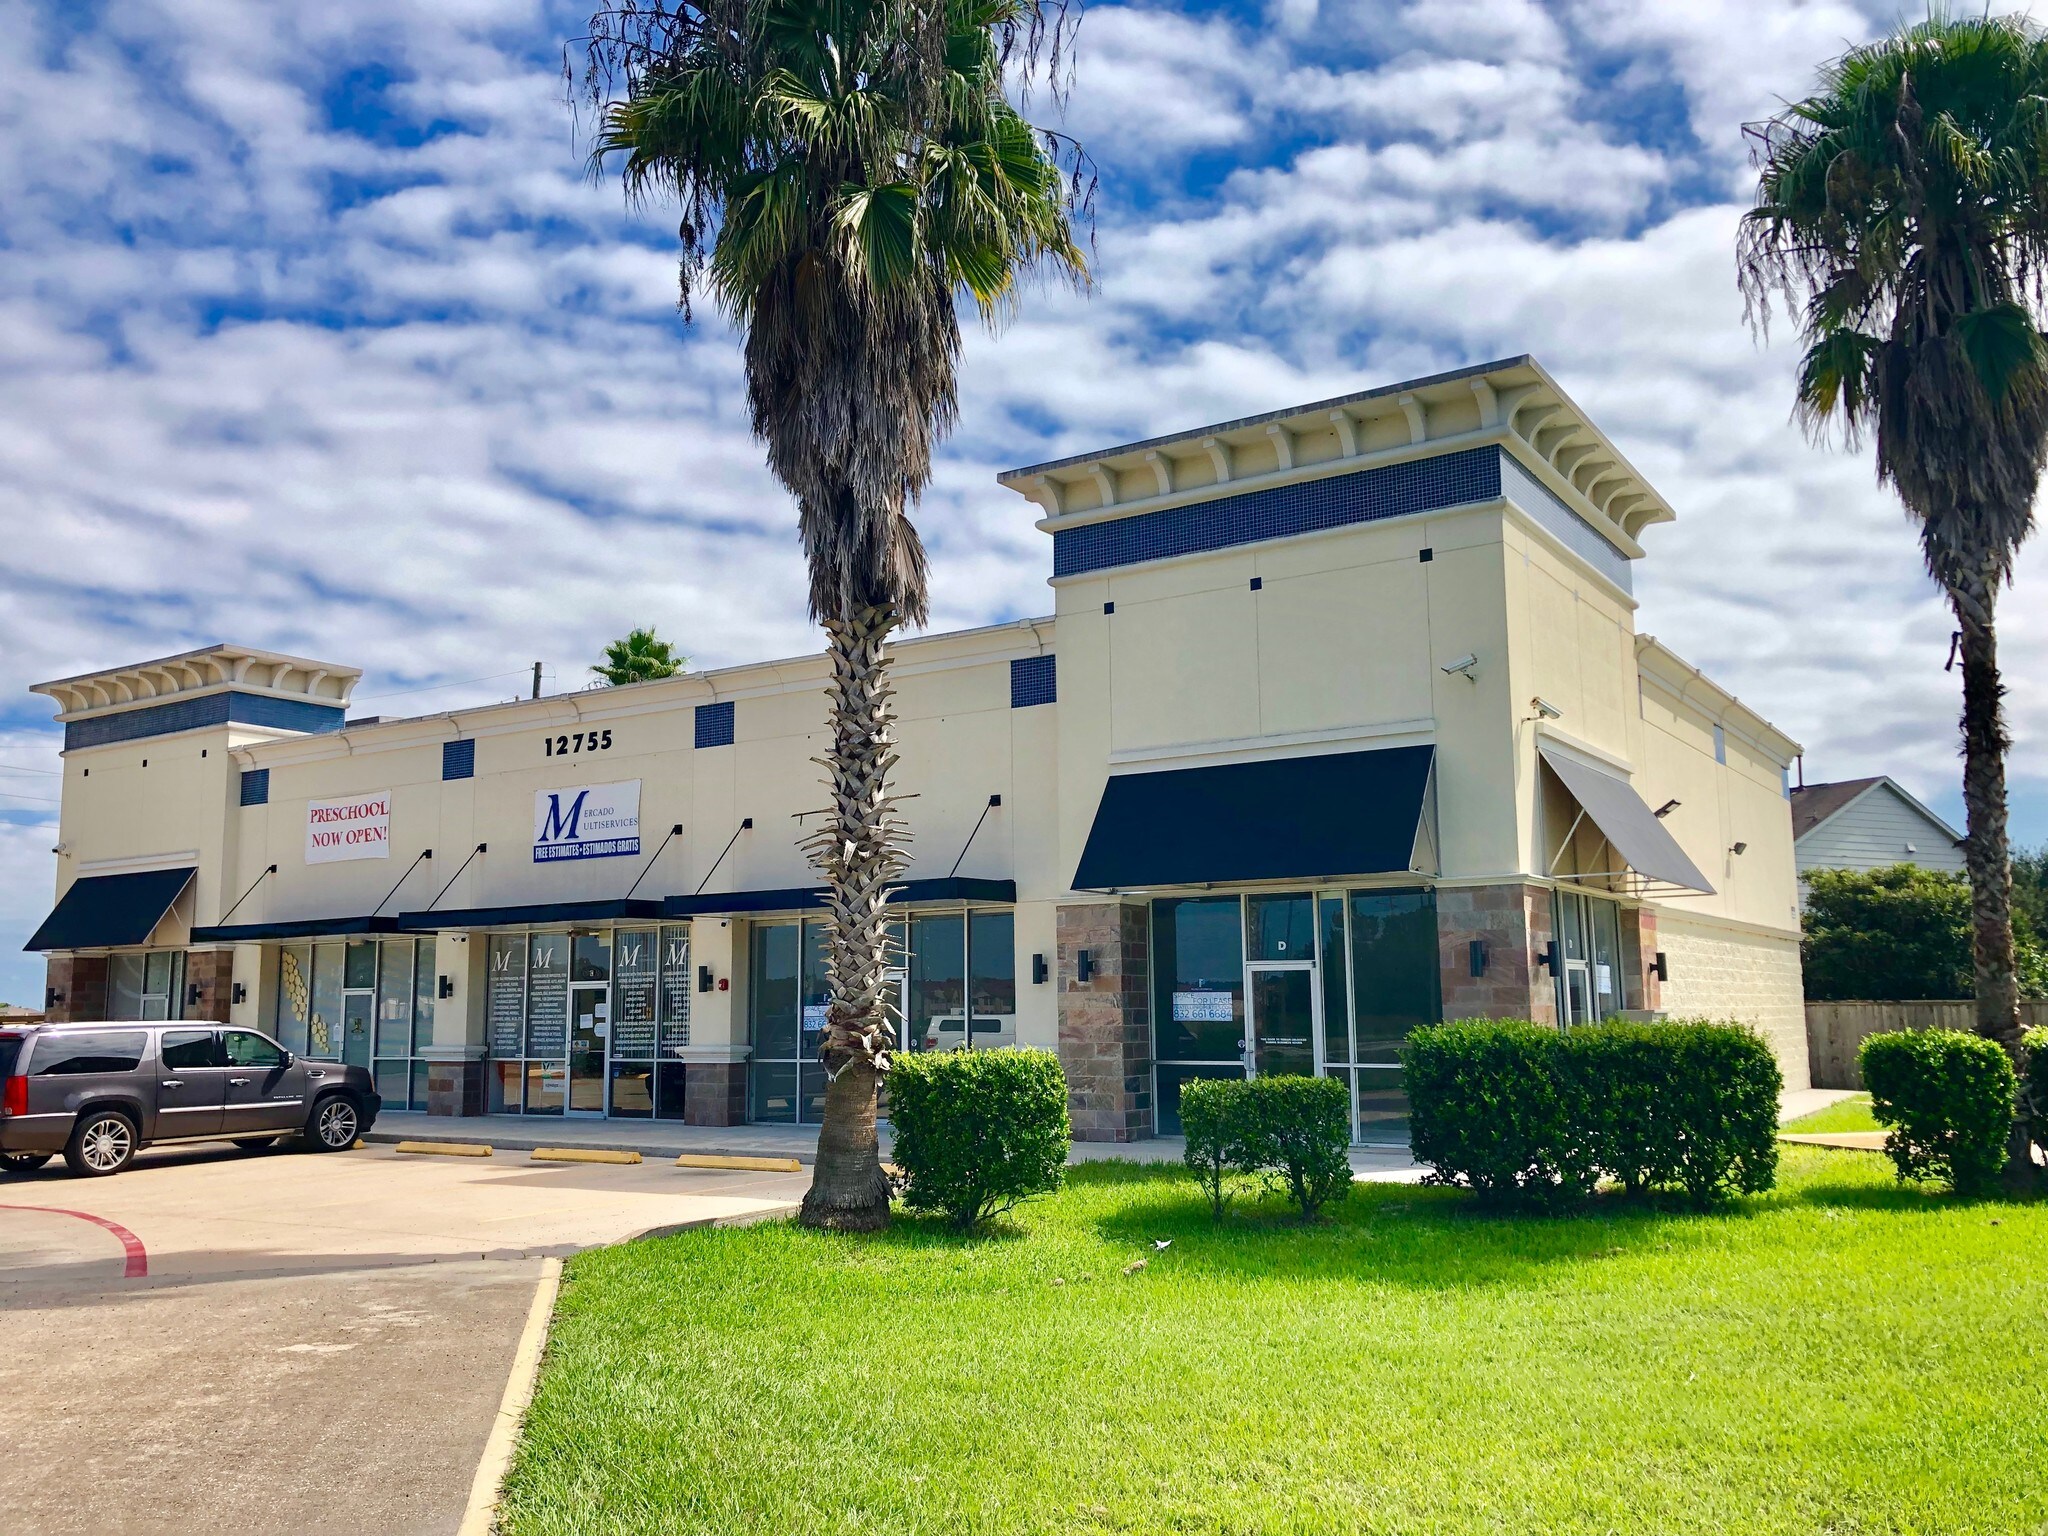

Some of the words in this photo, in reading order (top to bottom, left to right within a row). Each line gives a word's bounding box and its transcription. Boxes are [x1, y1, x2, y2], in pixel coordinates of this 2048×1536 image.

[545, 730, 612, 757] 12755
[310, 801, 389, 823] PRESCHOOL
[538, 790, 590, 842] M
[584, 807, 615, 818] ERCADO
[583, 817, 638, 831] ULTISERVICES
[312, 831, 343, 848] NOW
[346, 826, 387, 845] OPEN!
[535, 846, 549, 859] FREE
[548, 843, 580, 858] ESTIMATES
[582, 841, 617, 856] ESTIMADOS
[616, 838, 639, 853] GRATIS
[618, 944, 642, 967] M
[665, 942, 690, 966] M
[1278, 941, 1287, 951] D
[492, 950, 513, 972] M
[532, 947, 555, 969] M
[1174, 1009, 1190, 1019] 832
[1192, 1009, 1207, 1019] 661
[1208, 1009, 1232, 1019] 6684
